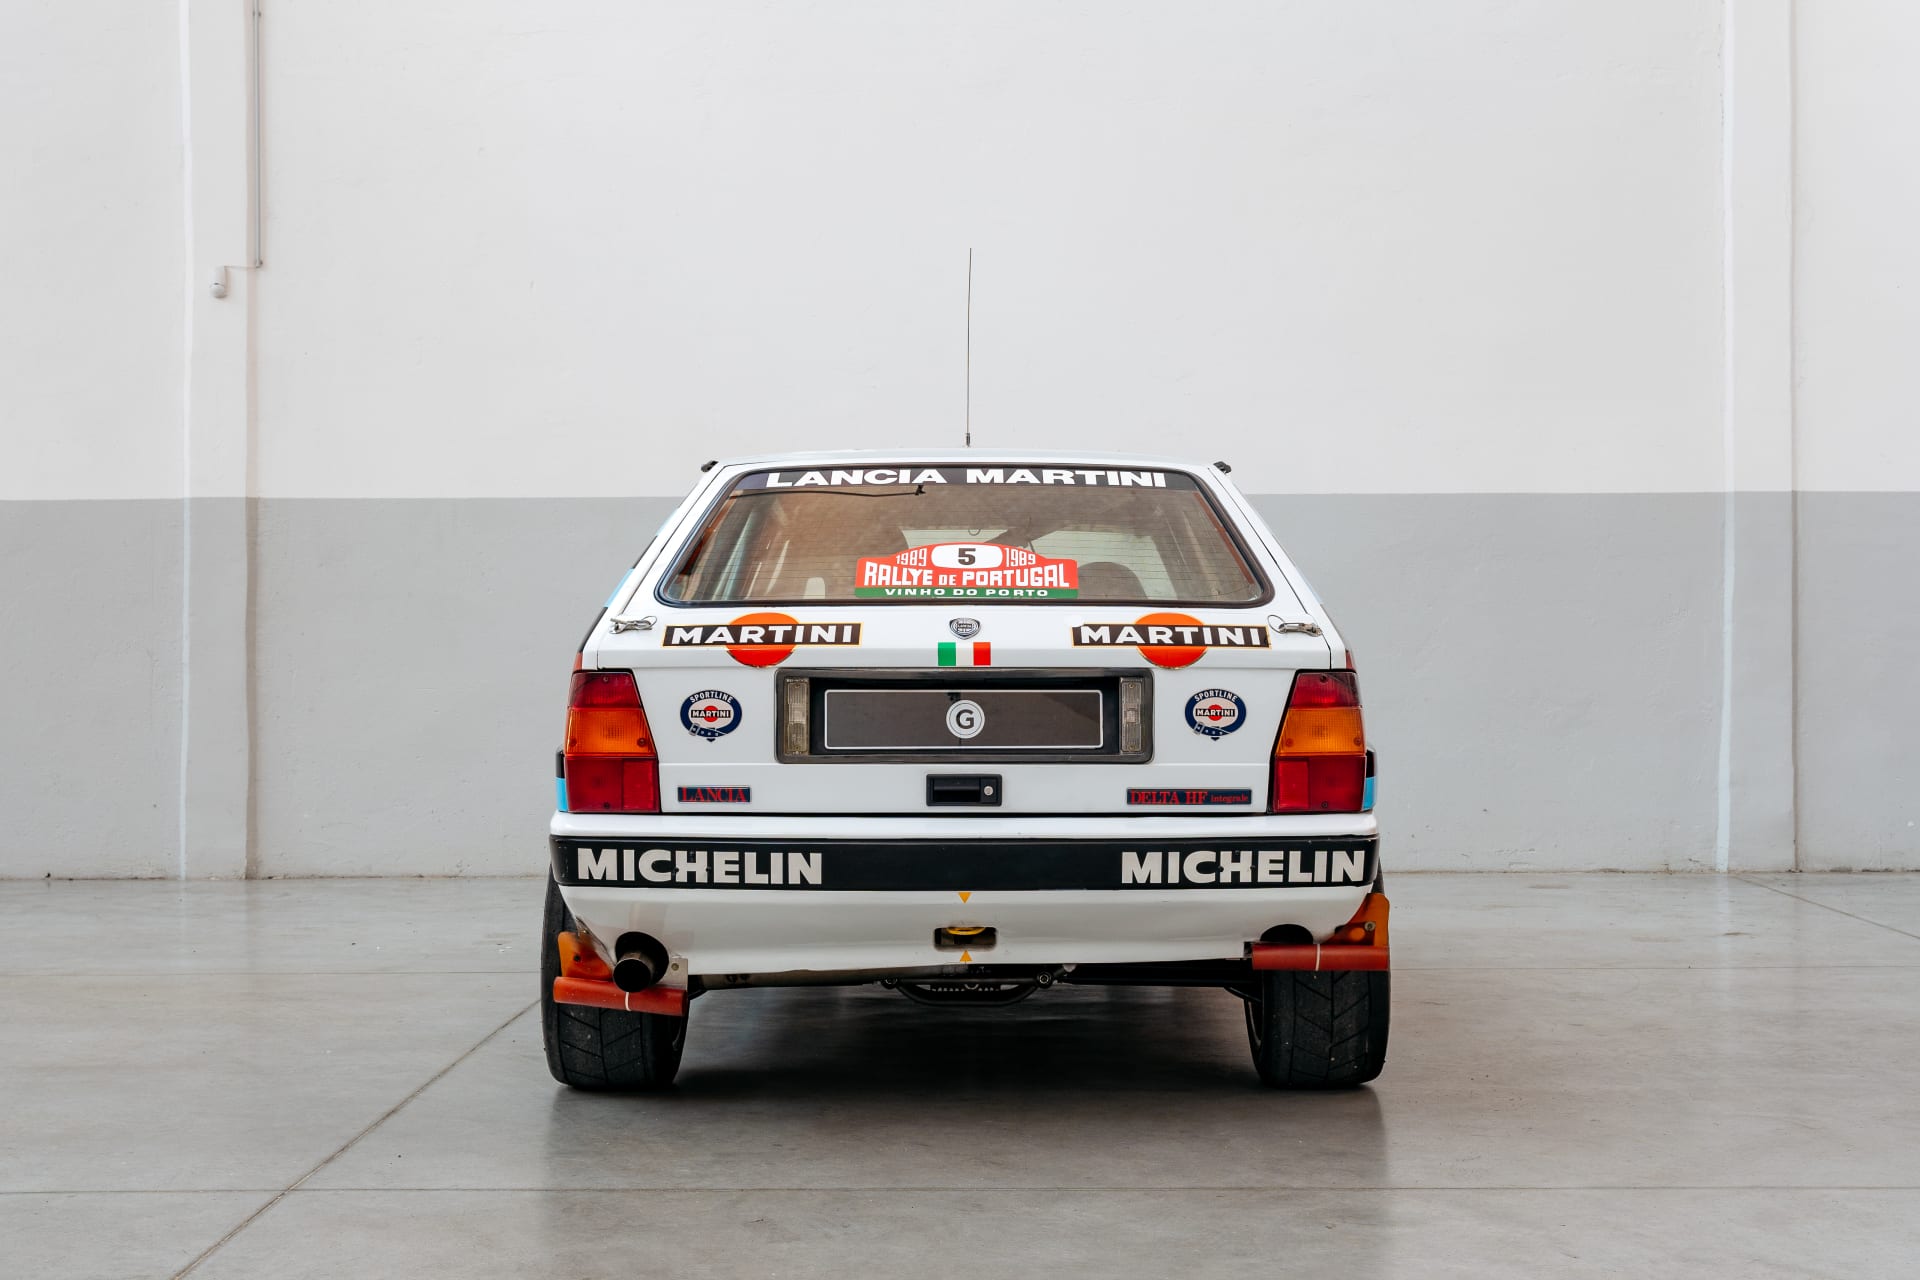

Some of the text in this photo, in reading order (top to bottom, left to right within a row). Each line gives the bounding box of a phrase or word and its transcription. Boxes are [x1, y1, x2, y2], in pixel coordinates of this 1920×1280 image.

[766, 468, 1166, 488] LANCIA MARTINI
[896, 547, 927, 567] 1989
[958, 548, 976, 565] 5
[1006, 547, 1036, 565] 1989
[864, 561, 1070, 587] RALLYE DE PORTUGAL
[884, 588, 1048, 597] VINHO DO PORTO
[671, 625, 854, 645] MARTINI
[1081, 625, 1261, 646] MARTINI
[690, 691, 733, 703] SPORTLINE
[1194, 690, 1238, 702] SPORTLINE
[692, 710, 729, 718] MARTINI
[955, 709, 975, 729] G
[1196, 709, 1234, 717] MARTINI
[681, 786, 747, 803] LANCIA
[1130, 790, 1180, 804] DELTA
[1185, 791, 1208, 804] HF
[577, 848, 822, 885] MICHELIN
[1121, 850, 1365, 884] MICHELIN
